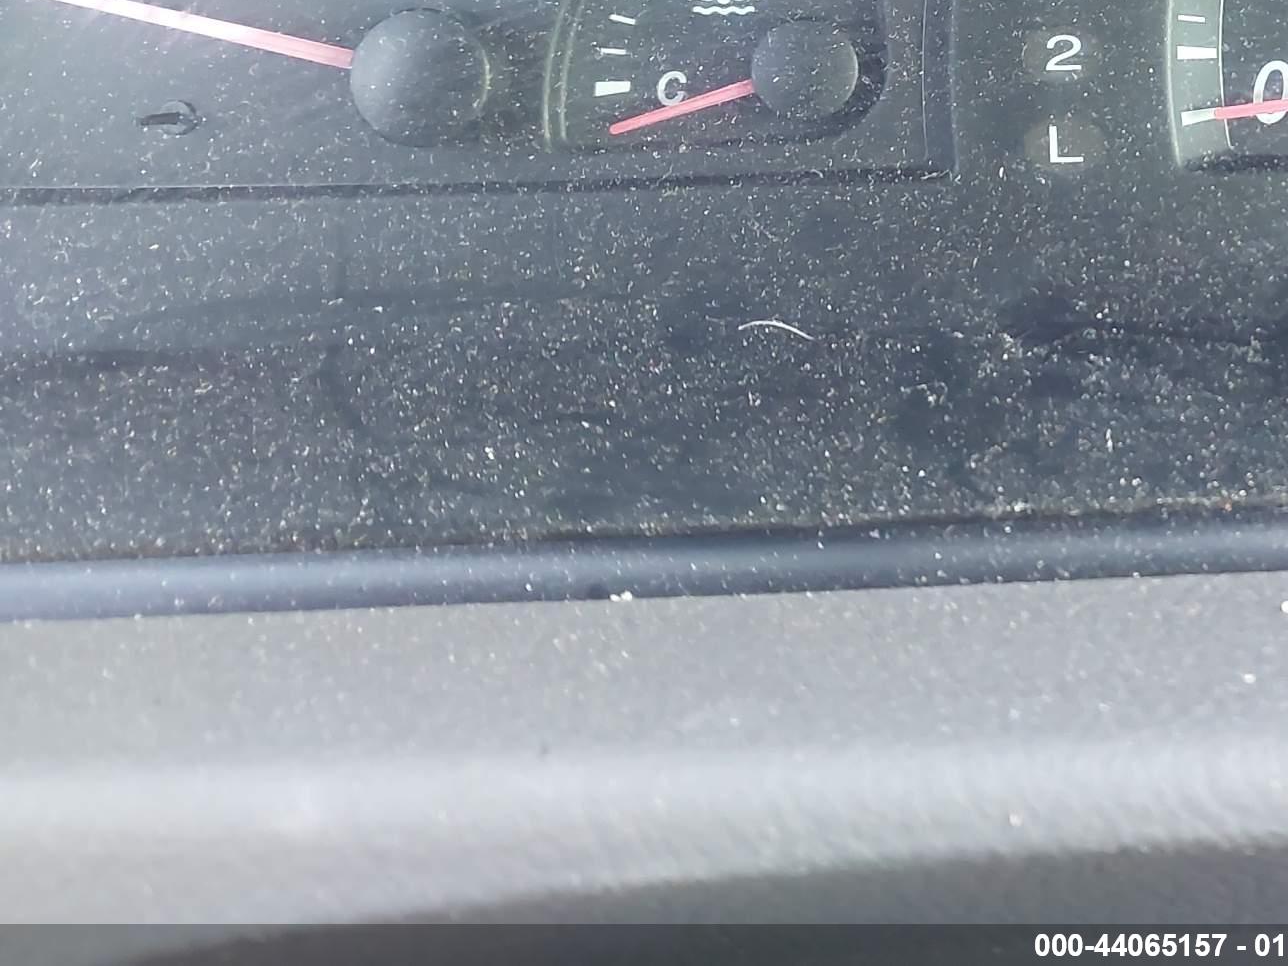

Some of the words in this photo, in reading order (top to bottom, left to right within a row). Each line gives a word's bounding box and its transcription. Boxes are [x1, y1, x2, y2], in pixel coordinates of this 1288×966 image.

[1045, 35, 1082, 70] 2
[658, 70, 687, 106] C
[1048, 125, 1084, 163] L
